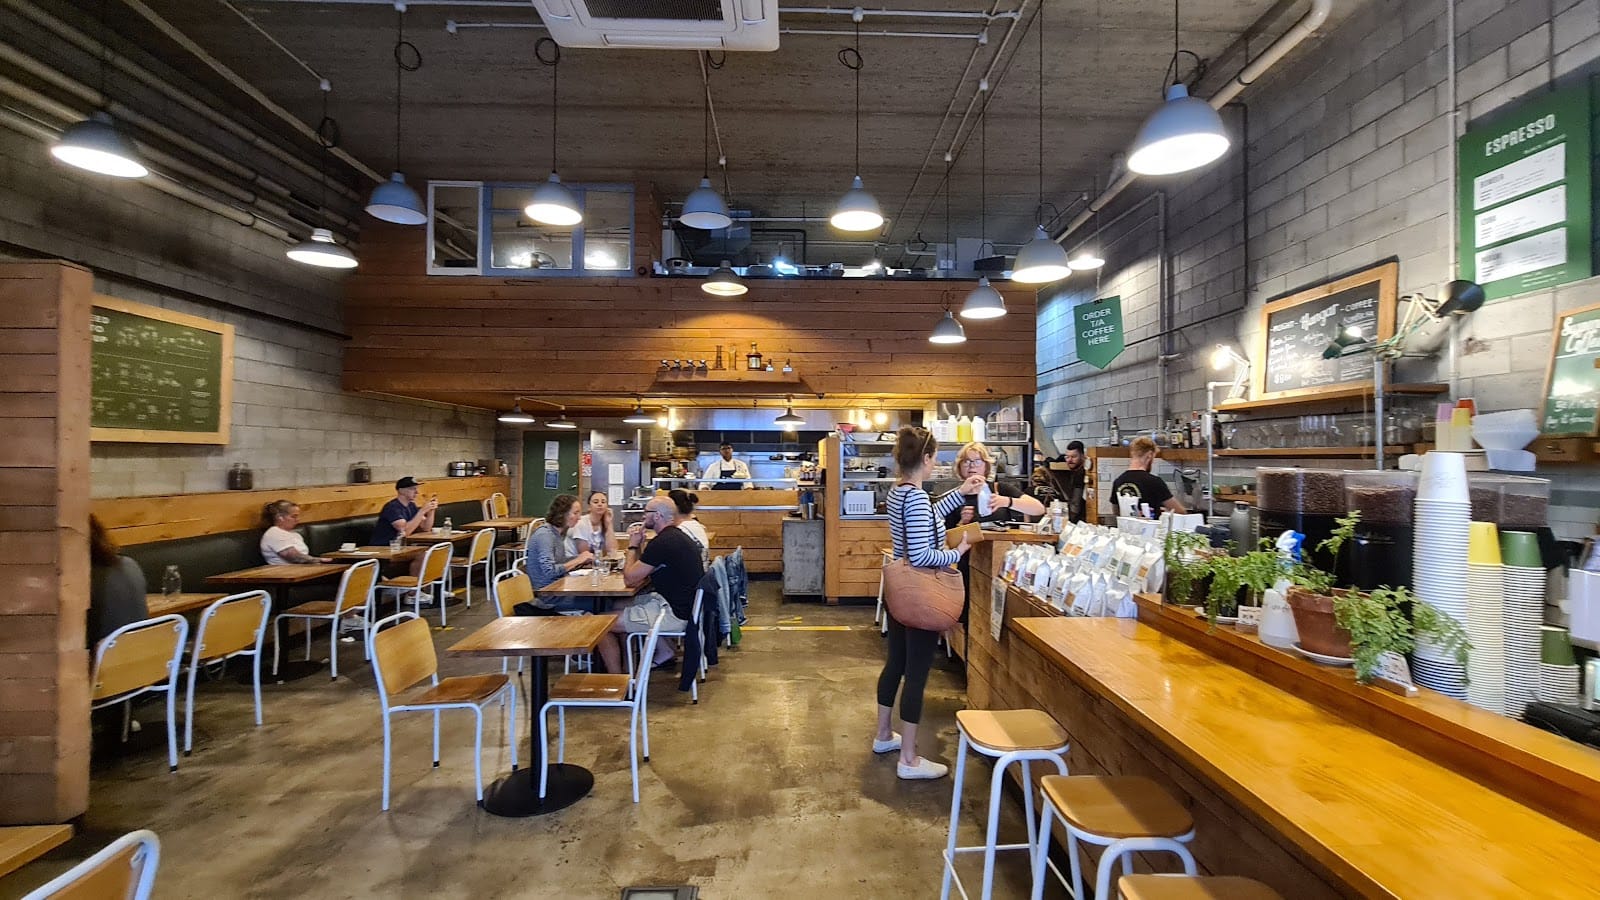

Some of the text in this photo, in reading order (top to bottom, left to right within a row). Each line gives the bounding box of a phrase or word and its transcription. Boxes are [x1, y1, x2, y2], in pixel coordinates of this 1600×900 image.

[1485, 113, 1555, 157] ESPRESSO
[1082, 308, 1112, 321] ORDER
[1090, 318, 1105, 328] T/A
[1082, 324, 1115, 338] COFFEE
[1087, 335, 1112, 346] HERE
